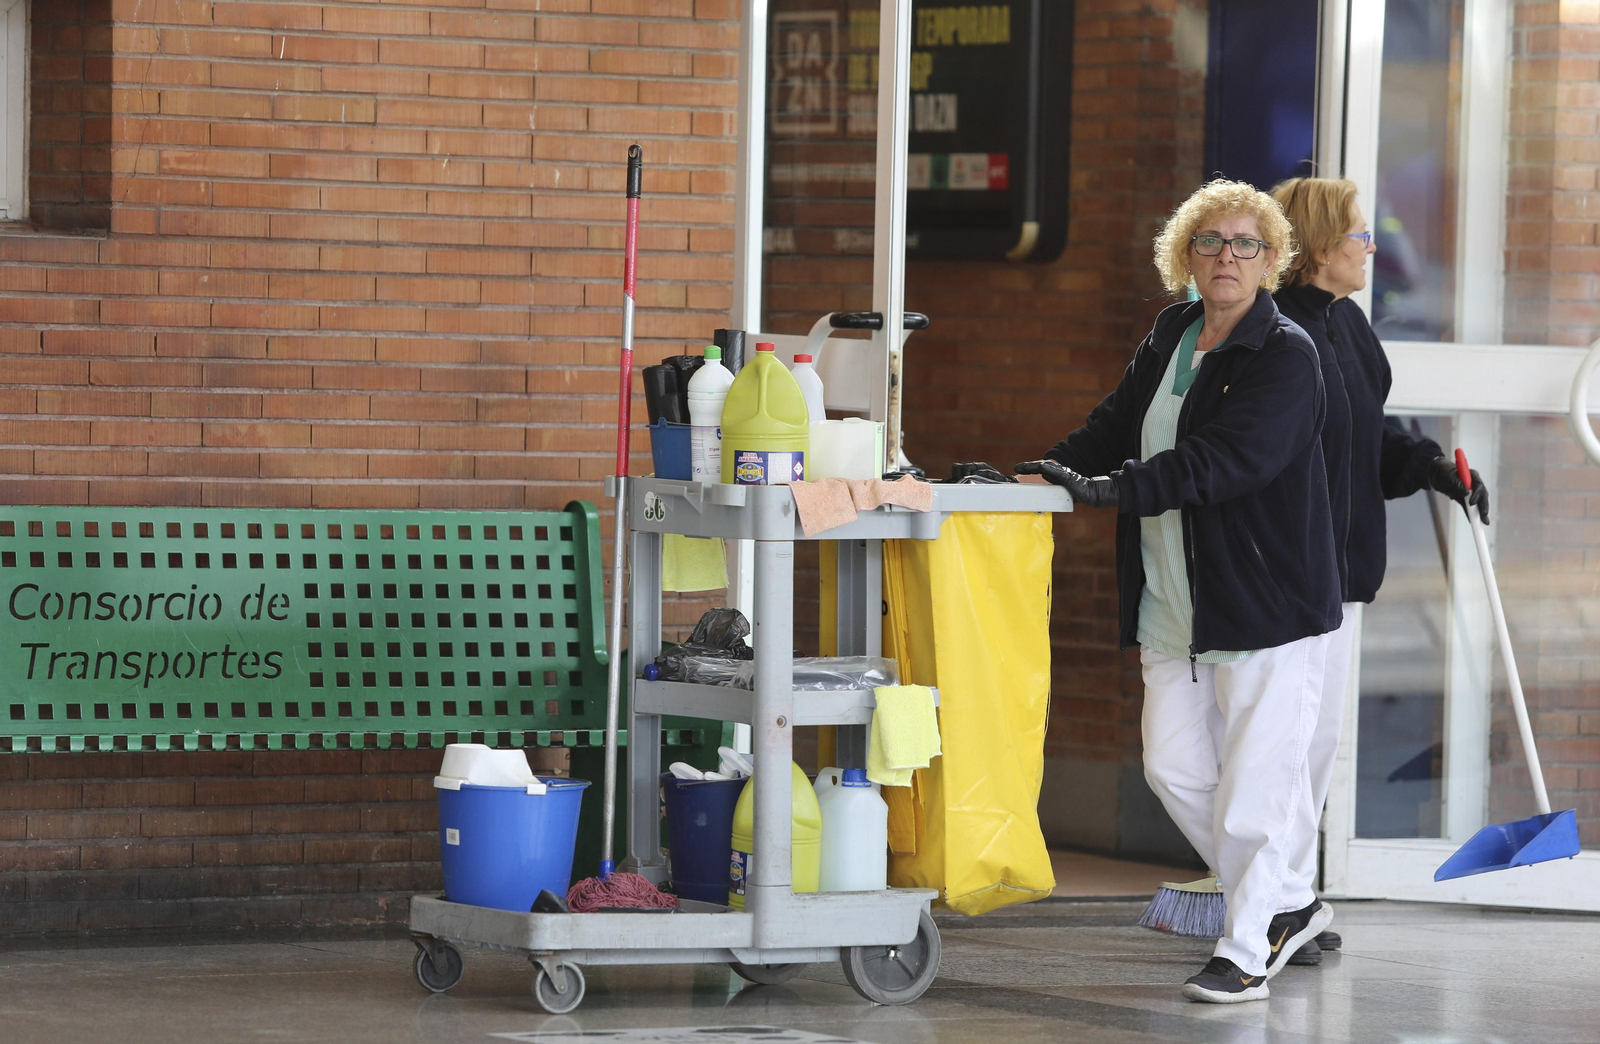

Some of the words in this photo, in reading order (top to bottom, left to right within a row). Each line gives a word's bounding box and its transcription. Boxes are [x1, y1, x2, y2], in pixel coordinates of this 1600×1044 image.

[916, 5, 1010, 46] TEMPORADA
[914, 93, 957, 132] DAZN
[9, 583, 223, 622] Consorcio
[240, 583, 290, 621] de
[20, 642, 283, 689] Transportes
